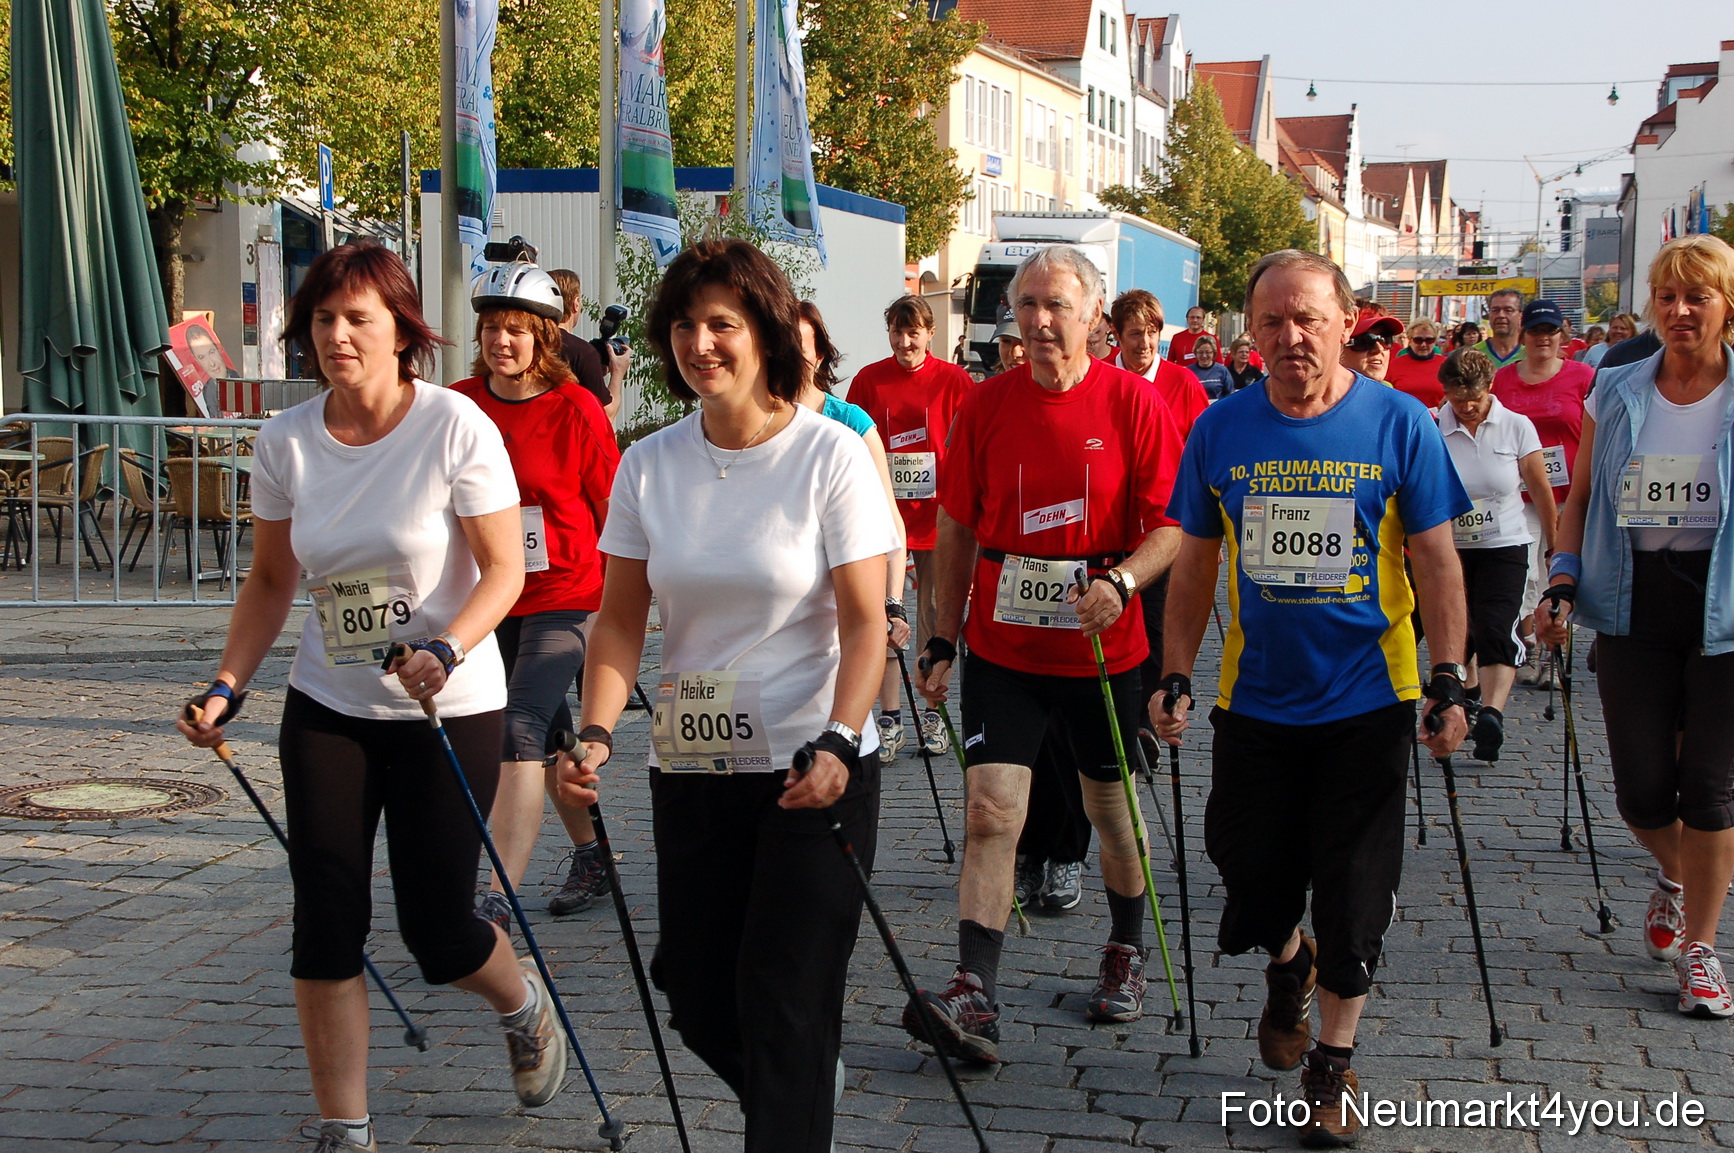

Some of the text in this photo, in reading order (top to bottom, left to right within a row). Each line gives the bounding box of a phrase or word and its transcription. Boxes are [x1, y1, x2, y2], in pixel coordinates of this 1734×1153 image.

[322, 153, 330, 201] P
[246, 244, 254, 265] 3
[1455, 282, 1497, 292] START
[191, 380, 204, 397] SPD
[894, 456, 924, 466] Gabriele
[894, 470, 930, 483] 8022
[1229, 460, 1383, 481] 10. NEUMARKTER
[1249, 477, 1356, 494] STADTLAUF
[1623, 480, 1631, 491] N
[1647, 481, 1711, 502] 8119
[1039, 509, 1067, 524] DEHN
[1271, 503, 1311, 521] Franz
[1458, 510, 1494, 527] 8094
[1678, 515, 1717, 523] PFLEIDERER
[1246, 529, 1254, 541] N
[1272, 530, 1342, 557] 8088
[1022, 557, 1049, 573] Hans
[1001, 574, 1008, 585] N
[1307, 572, 1347, 581] PFLEIDERER
[332, 580, 371, 598] Maria
[319, 610, 328, 624] N
[342, 600, 411, 634] 8079
[1049, 616, 1081, 624] PFLEIDER
[680, 680, 715, 699] Heike
[655, 712, 663, 726] N
[680, 713, 754, 741] 8005
[726, 756, 771, 766] PFLEIDERER
